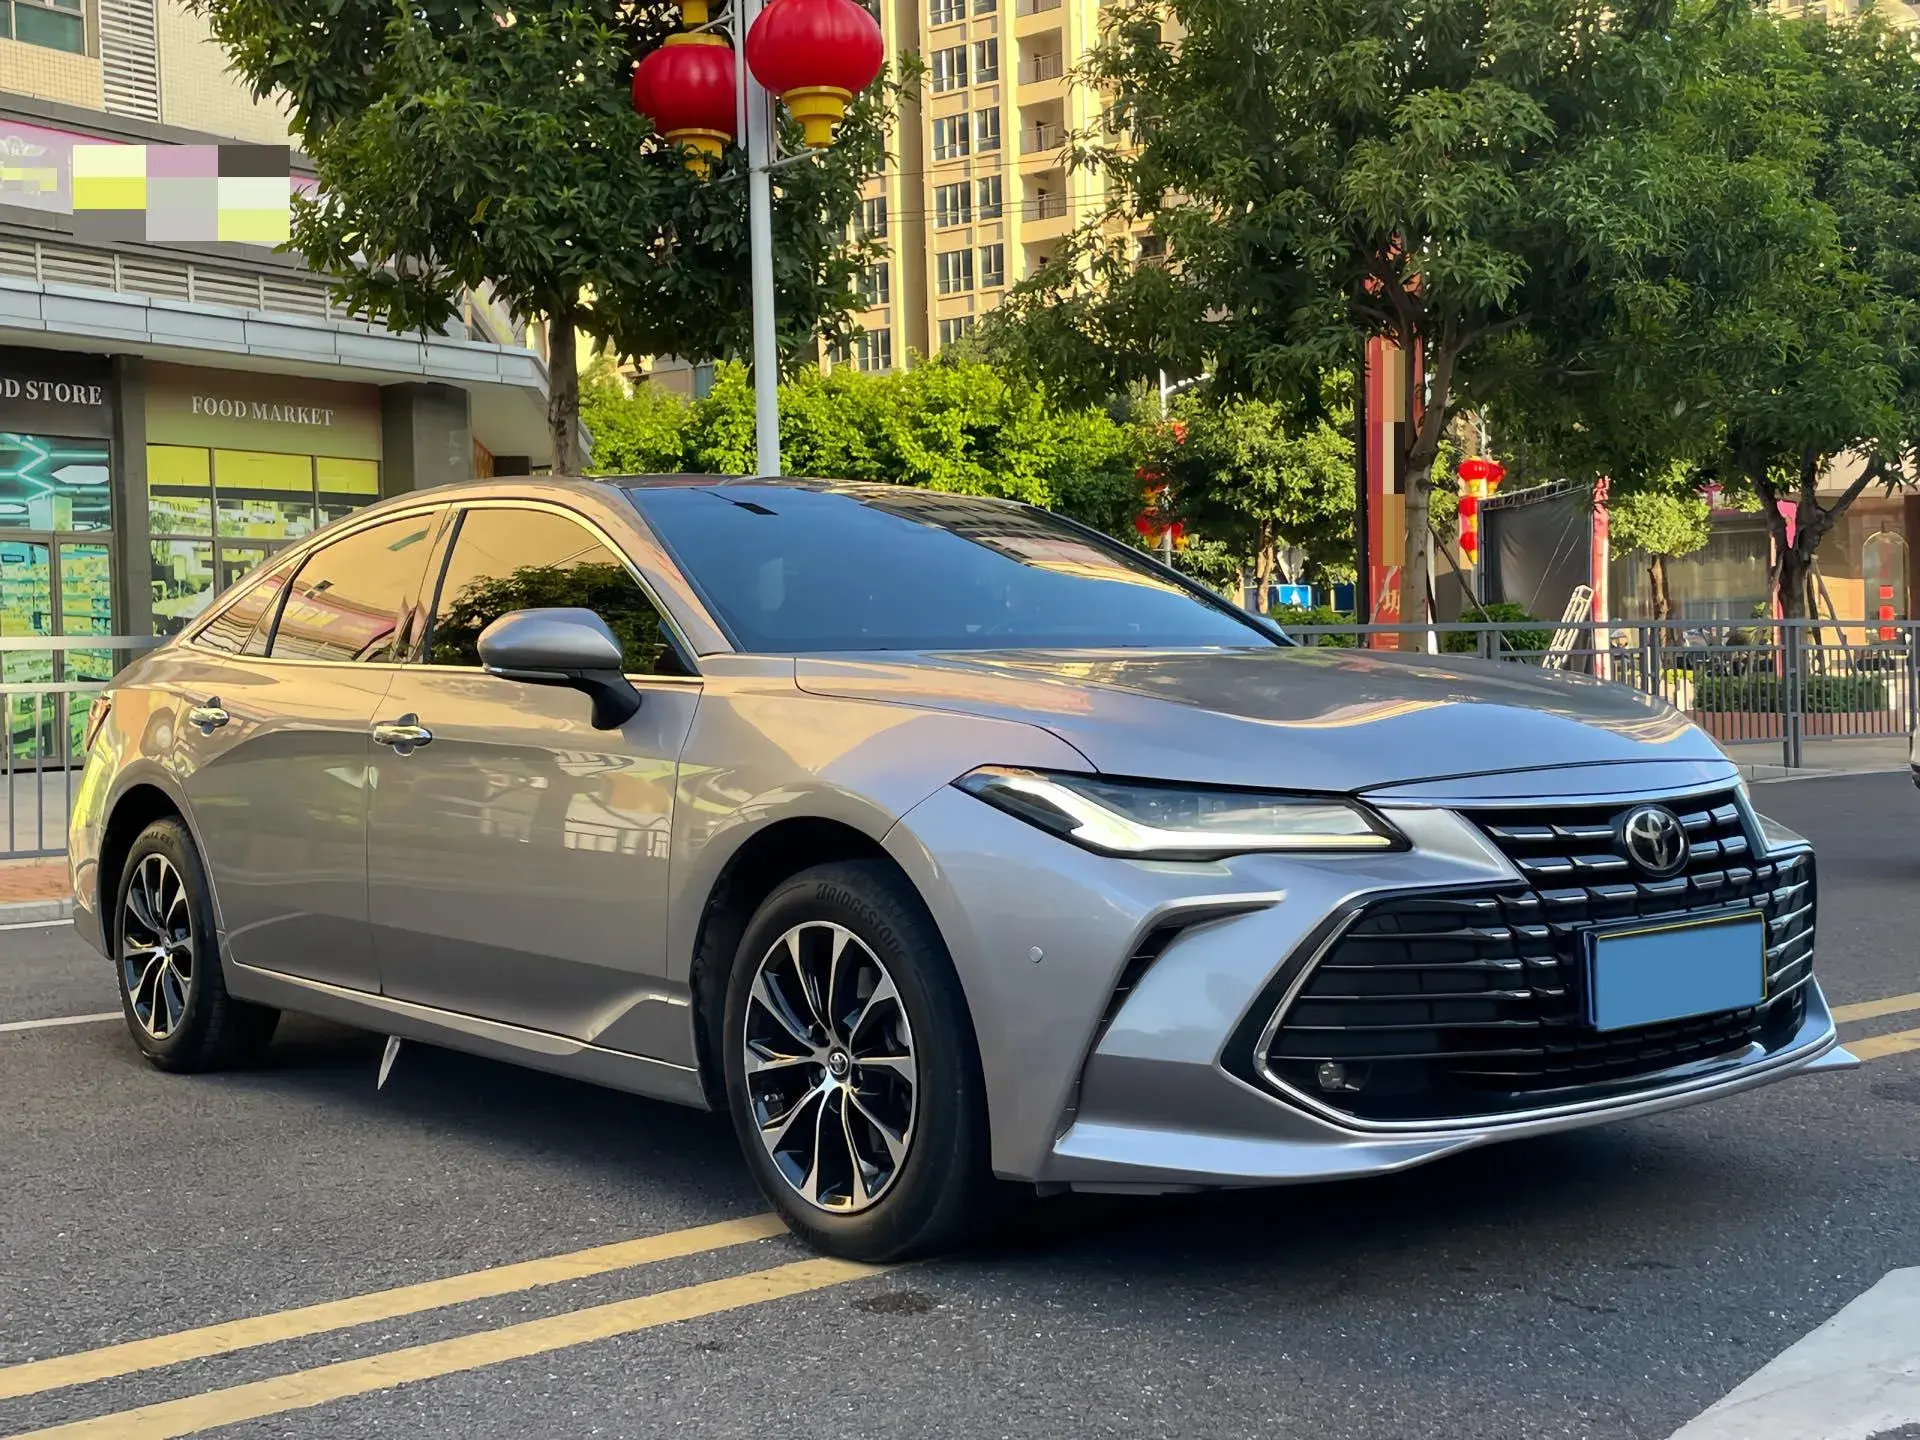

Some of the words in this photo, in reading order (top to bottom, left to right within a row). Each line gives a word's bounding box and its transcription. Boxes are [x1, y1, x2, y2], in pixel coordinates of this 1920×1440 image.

[25, 380, 102, 405] STORE
[191, 395, 247, 418] FOOD
[251, 402, 334, 426] MARKET
